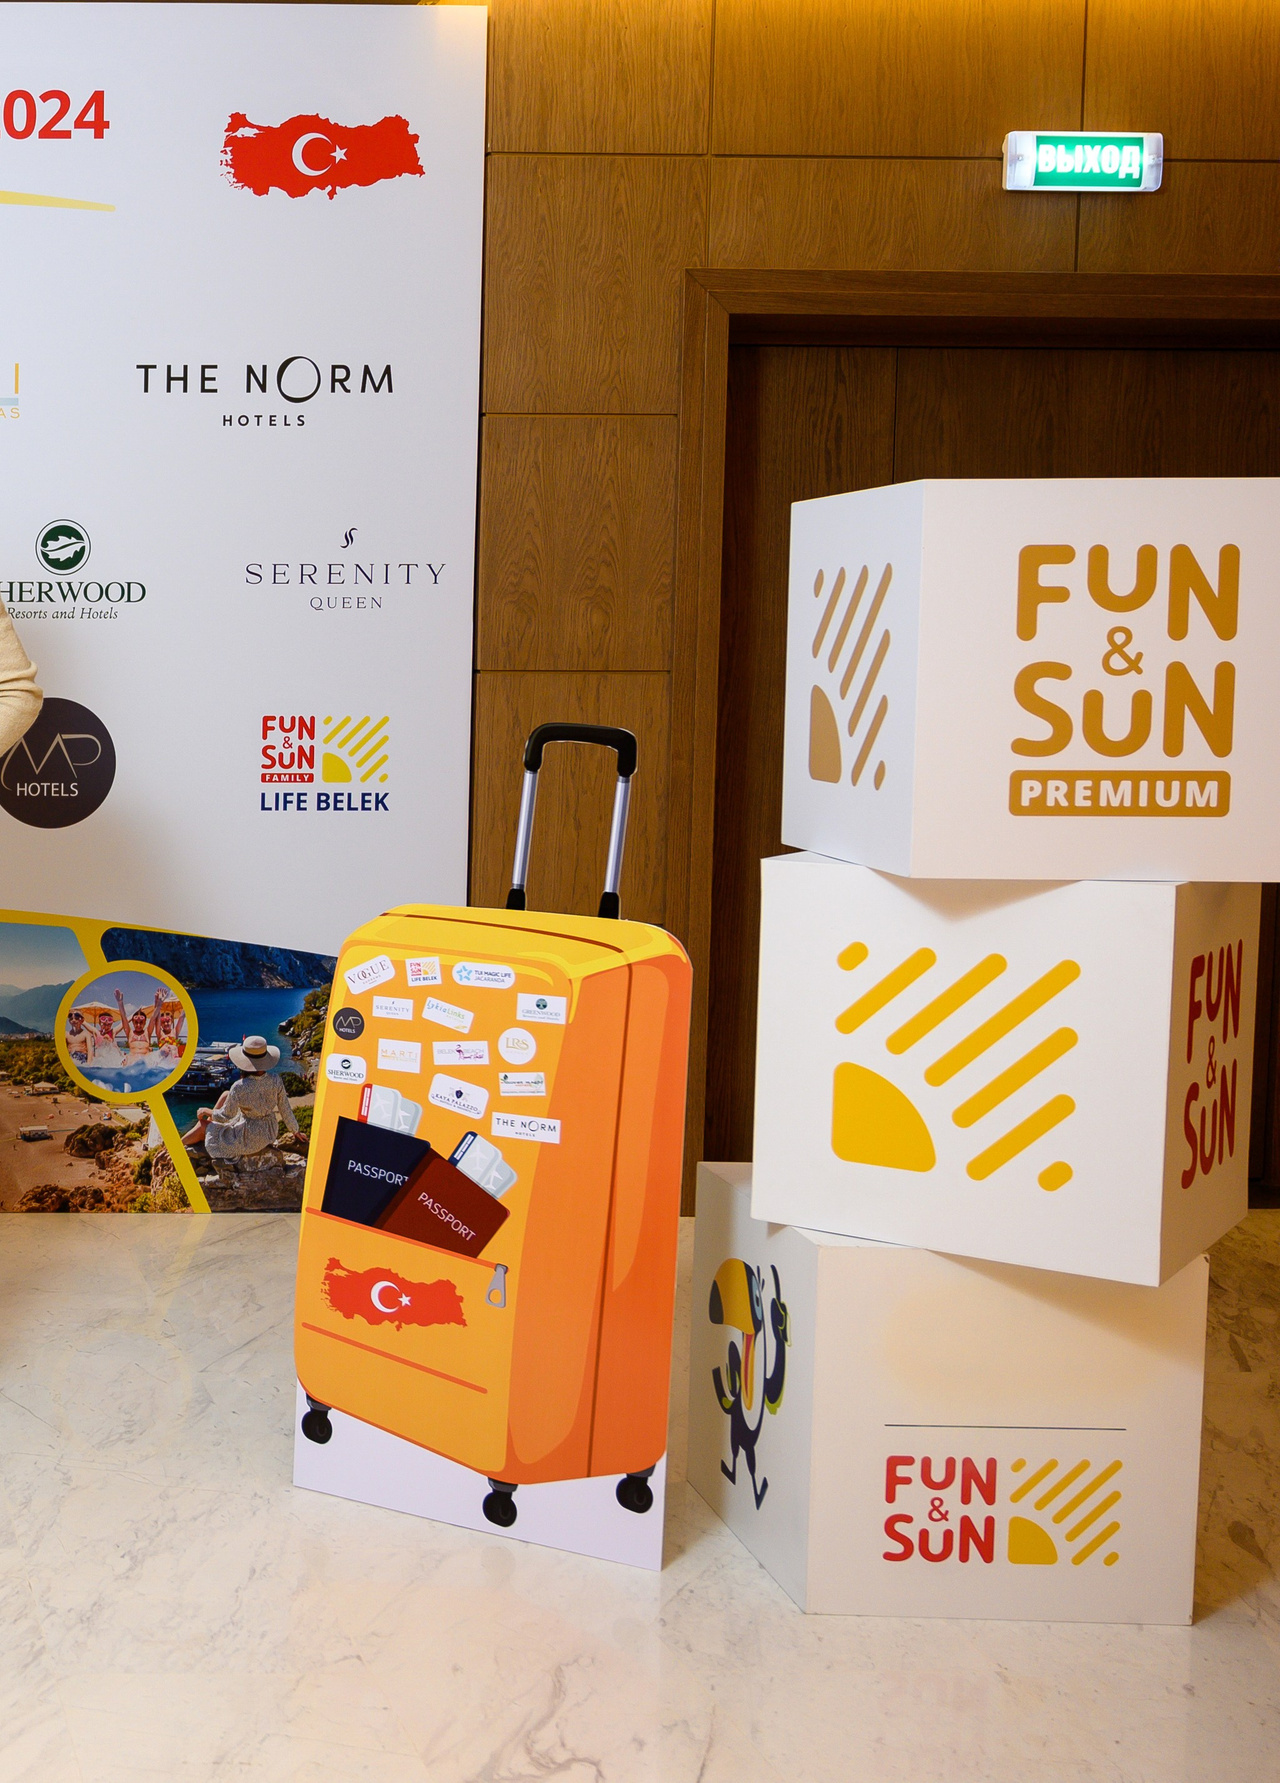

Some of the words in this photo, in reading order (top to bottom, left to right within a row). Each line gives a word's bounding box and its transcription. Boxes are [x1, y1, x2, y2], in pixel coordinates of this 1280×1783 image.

[1038, 144, 1141, 179] ВЫХОД
[136, 364, 218, 394] THE
[246, 355, 394, 404] NORM
[222, 414, 306, 427] HOTELS
[244, 563, 447, 585] SERENITY
[309, 596, 383, 612] QUEEN
[1016, 544, 1240, 641] FUN
[7, 607, 48, 619] Resorts
[52, 607, 75, 619] and
[80, 607, 118, 619] Hotels
[1102, 626, 1143, 676] &
[1010, 660, 1236, 758] SUN
[262, 716, 315, 740] FUN
[283, 736, 293, 749] &
[261, 745, 315, 769] SUN
[16, 783, 78, 796] HOTELS
[261, 792, 308, 811] LIFE
[316, 792, 389, 811] BELEK
[1020, 780, 1218, 807] PREMIUM
[348, 960, 390, 984] VOGUE
[1187, 938, 1243, 1064] FUN
[506, 1037, 529, 1050] LRS
[328, 1069, 364, 1079] SHERWOOD
[1206, 1035, 1217, 1089] &
[496, 1118, 515, 1127] THE
[521, 1120, 556, 1132] NORM
[1181, 1058, 1237, 1190] SUN
[418, 1192, 476, 1241] PASSPORT
[885, 1456, 997, 1506] FUN
[928, 1497, 949, 1522] &
[883, 1514, 995, 1564] SUN
